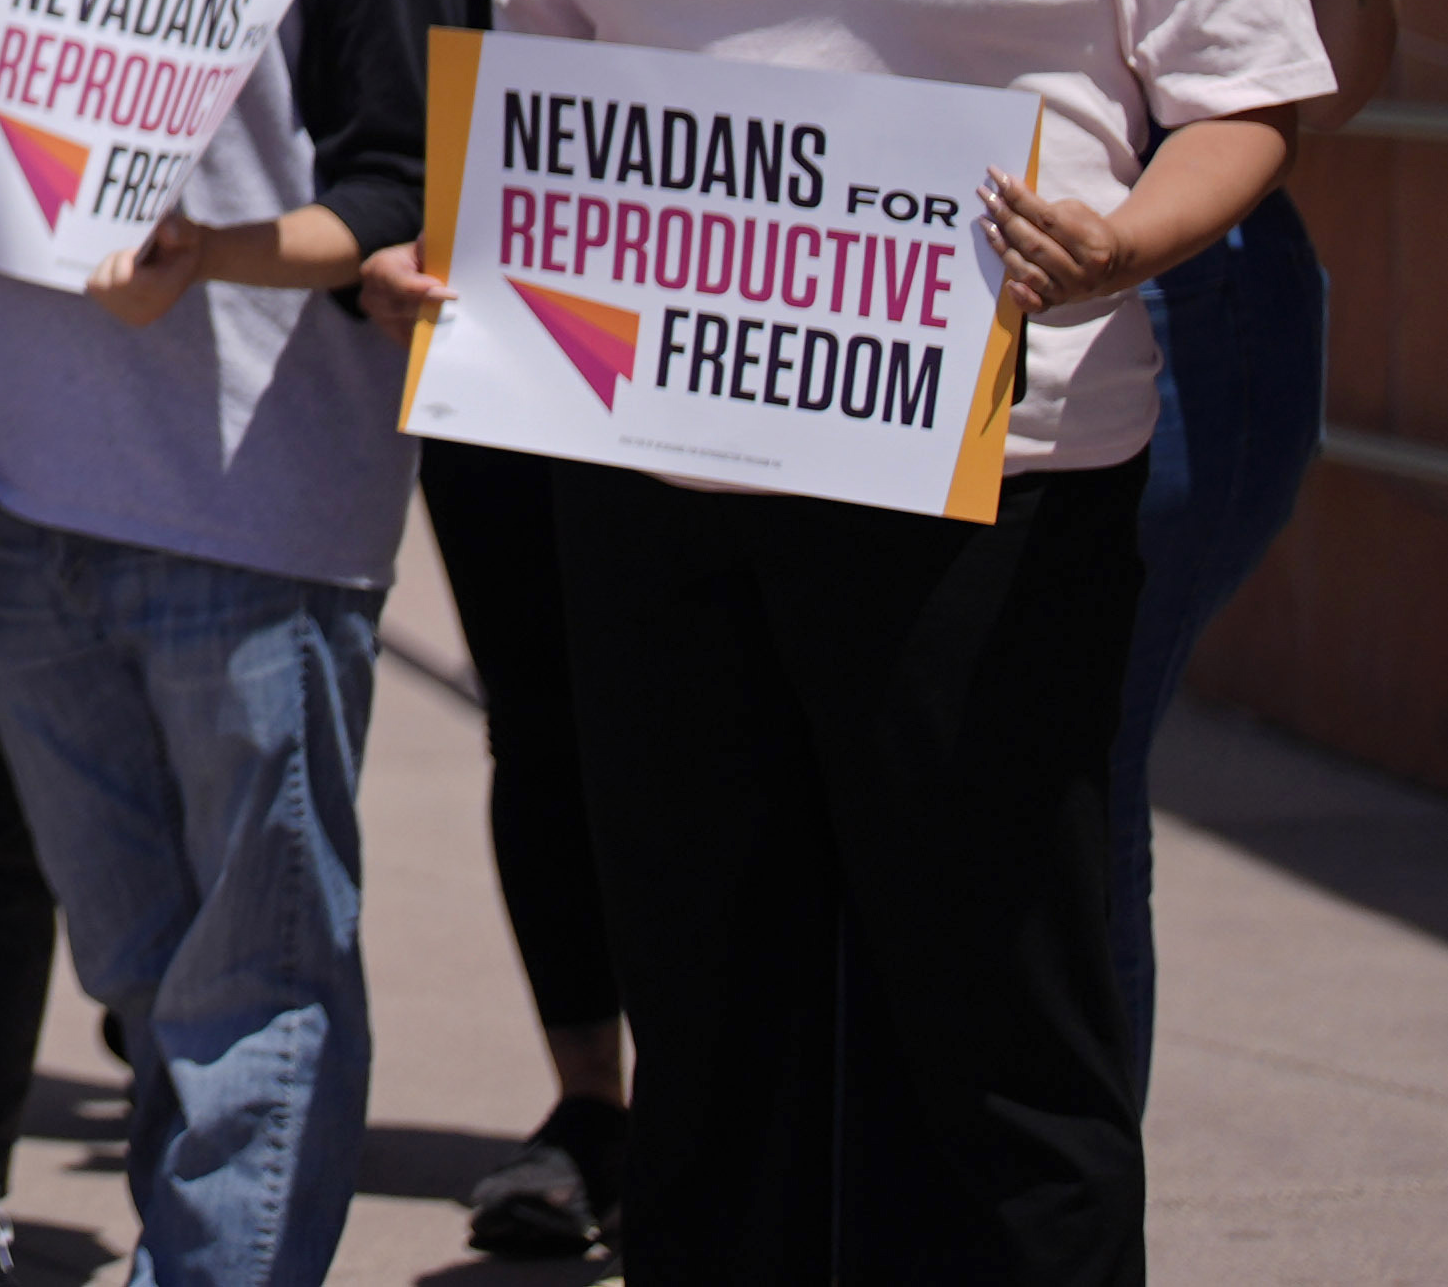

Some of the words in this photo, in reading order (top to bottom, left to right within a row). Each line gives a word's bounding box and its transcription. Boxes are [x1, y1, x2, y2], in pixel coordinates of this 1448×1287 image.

[503, 89, 827, 208] NEVADANS
[847, 186, 960, 228] FOR
[500, 185, 956, 329] REPRODUCTIVE
[656, 308, 944, 429] FREEDOM
